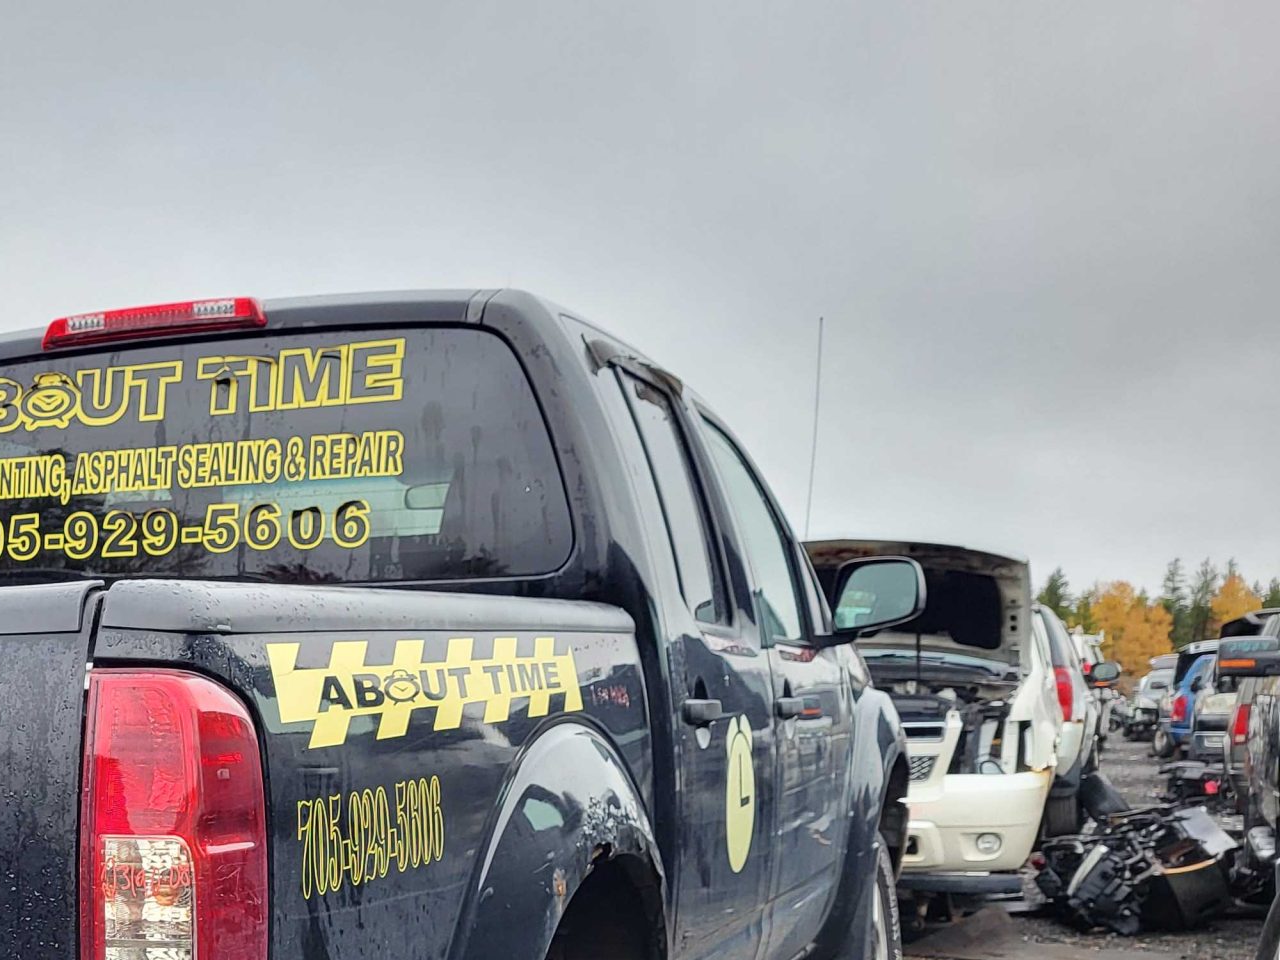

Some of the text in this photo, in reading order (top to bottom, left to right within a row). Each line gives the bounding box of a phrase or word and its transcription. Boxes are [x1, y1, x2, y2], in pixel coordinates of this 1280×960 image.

[197, 337, 407, 416] TIME
[72, 445, 178, 496] ASPHALT
[177, 437, 283, 489] SEALING
[284, 435, 307, 482] &
[308, 430, 405, 481] REPAIR
[482, 662, 562, 696] TIME
[297, 774, 444, 901] 705-929-5606
